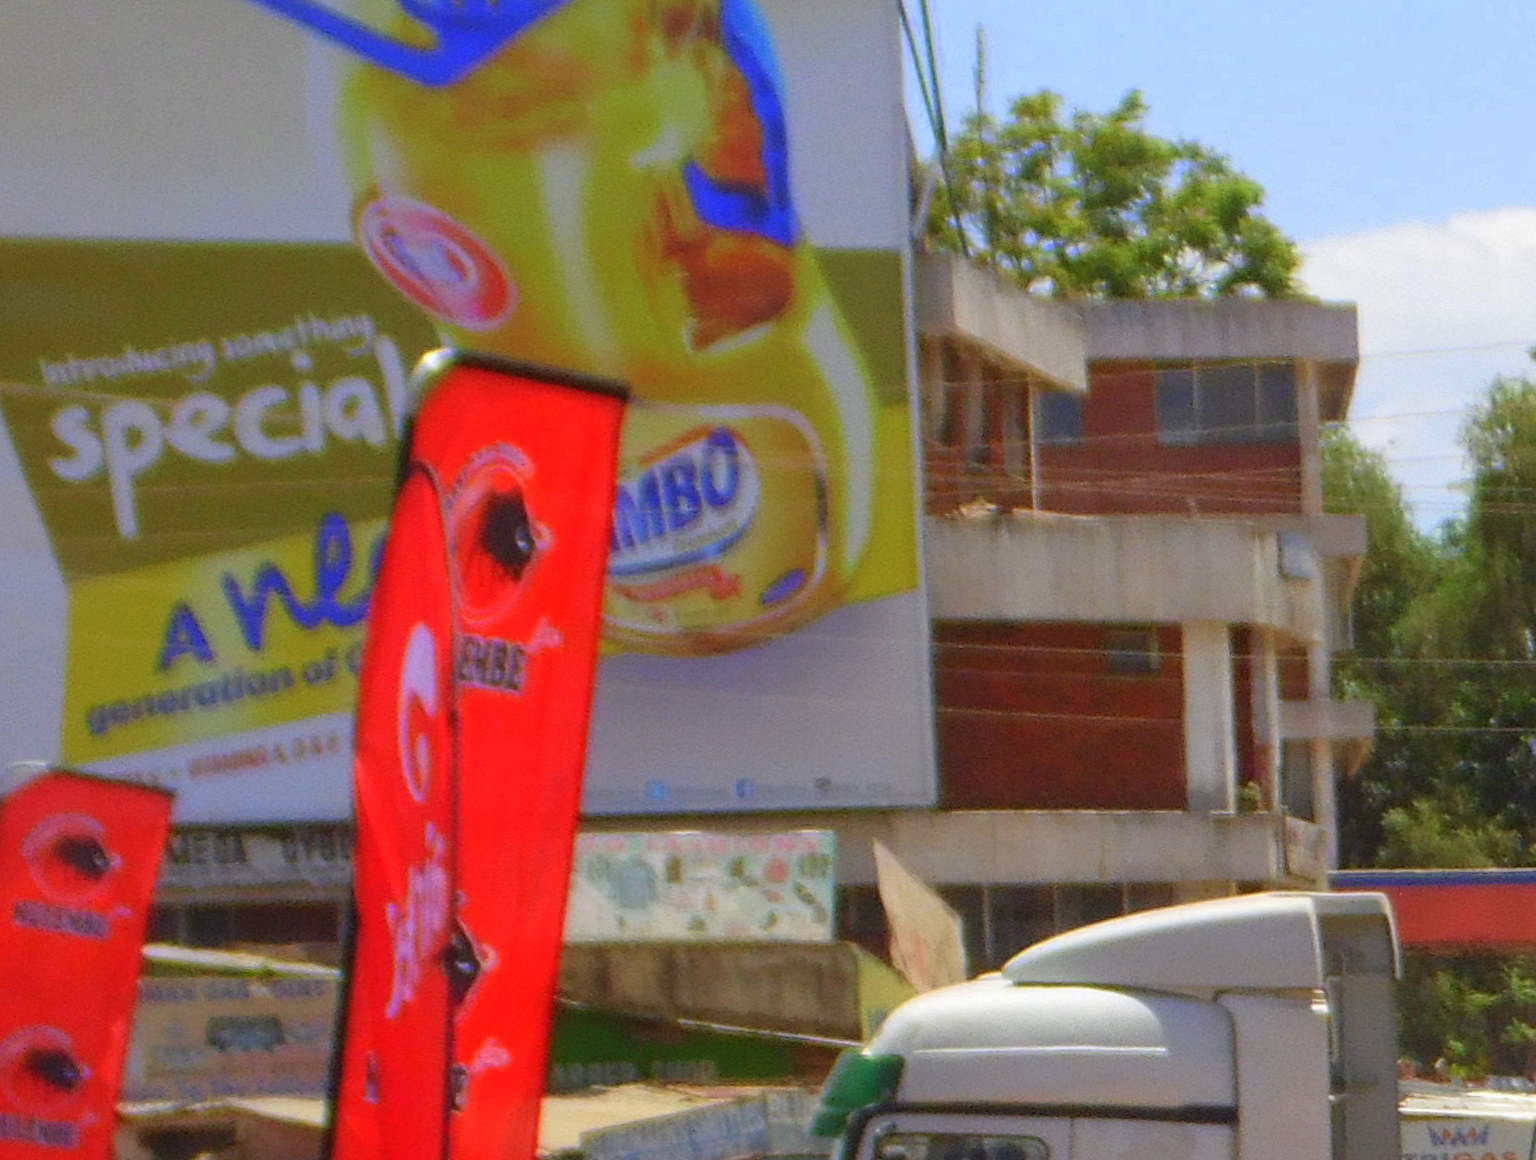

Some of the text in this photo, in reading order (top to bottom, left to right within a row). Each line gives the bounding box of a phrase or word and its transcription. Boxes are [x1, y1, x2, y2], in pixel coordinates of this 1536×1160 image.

[49, 336, 402, 540] special
[611, 425, 741, 554] MBO
[158, 601, 215, 673] A
[87, 666, 295, 738] generation
[303, 649, 339, 686] of
